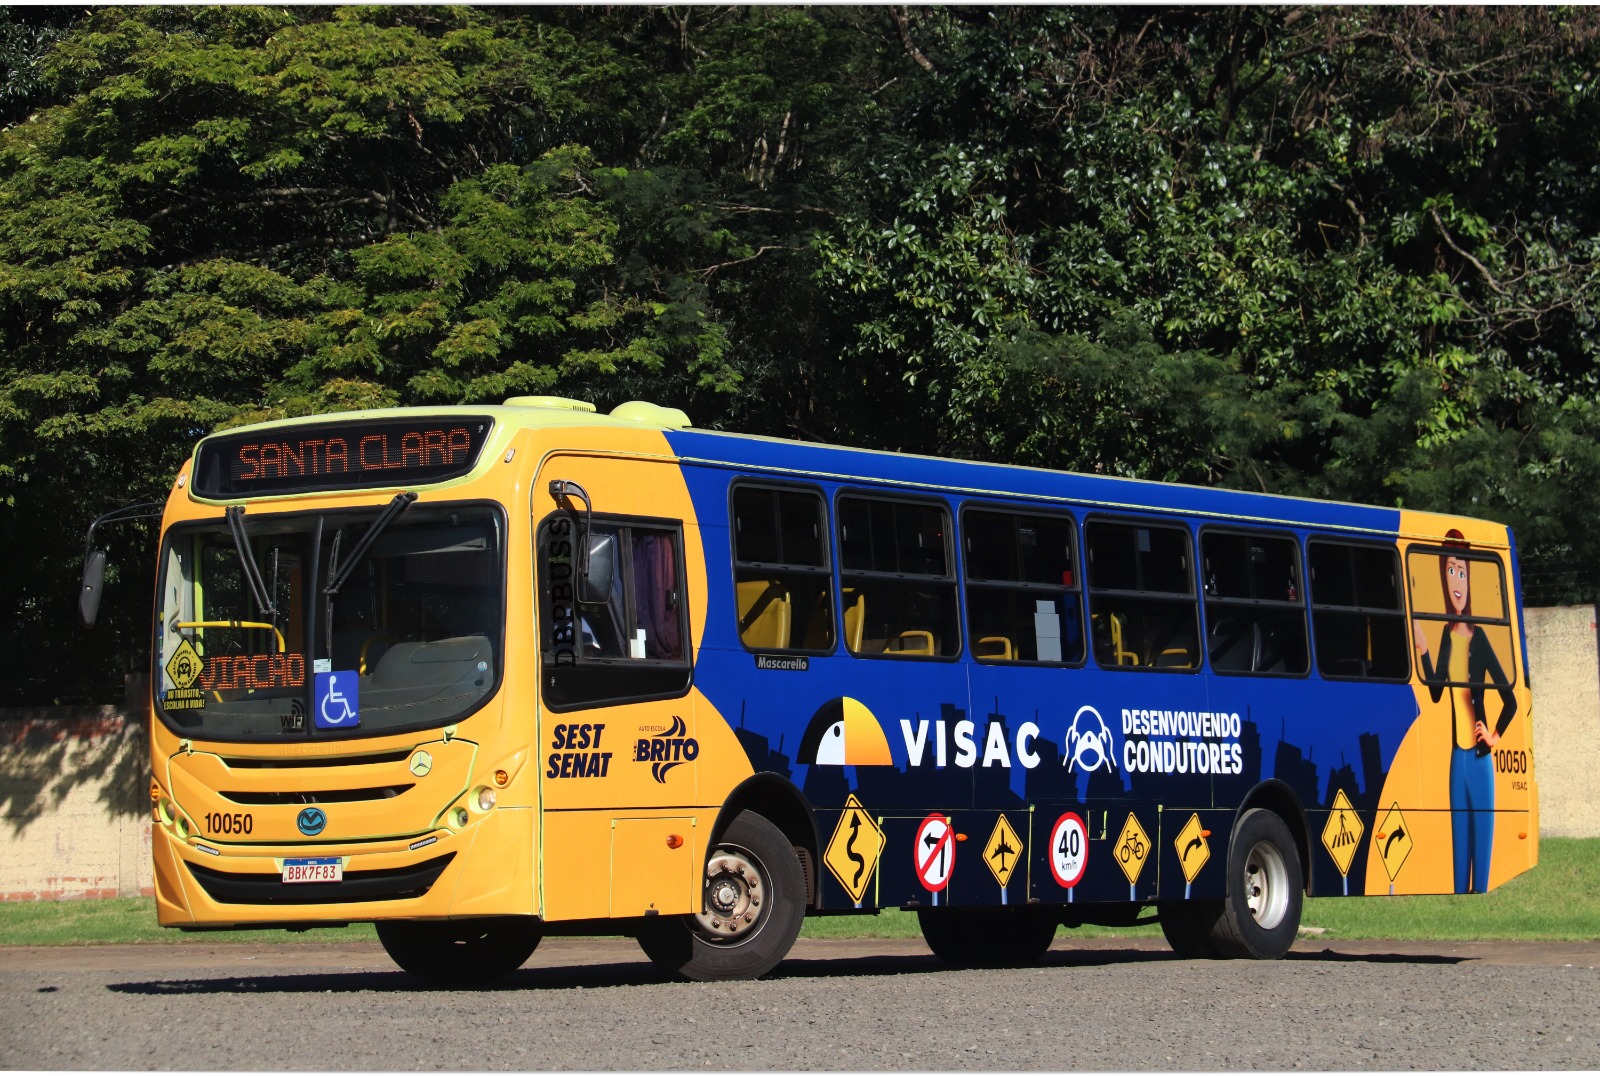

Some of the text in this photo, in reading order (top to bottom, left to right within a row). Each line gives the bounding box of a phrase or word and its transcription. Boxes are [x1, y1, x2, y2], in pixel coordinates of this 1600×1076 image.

[239, 428, 470, 479] SANTA CLARA
[757, 656, 808, 671] Mascarello
[163, 699, 205, 710] ESCOLHA A VIDA!
[167, 690, 175, 699] NO
[1121, 708, 1242, 738] DESENVOLVENDO
[552, 723, 606, 750] SEST
[899, 718, 1041, 769] VISAC
[636, 738, 700, 762] BRITO
[1123, 739, 1244, 775] CONDUTORES
[1493, 748, 1527, 775] 10050
[546, 752, 613, 779] SENAT
[1511, 781, 1528, 791] VISAC
[204, 812, 253, 835] 10050
[1058, 828, 1080, 860] 40
[288, 865, 337, 880] BBK7F83
[1060, 860, 1079, 871] km/h
